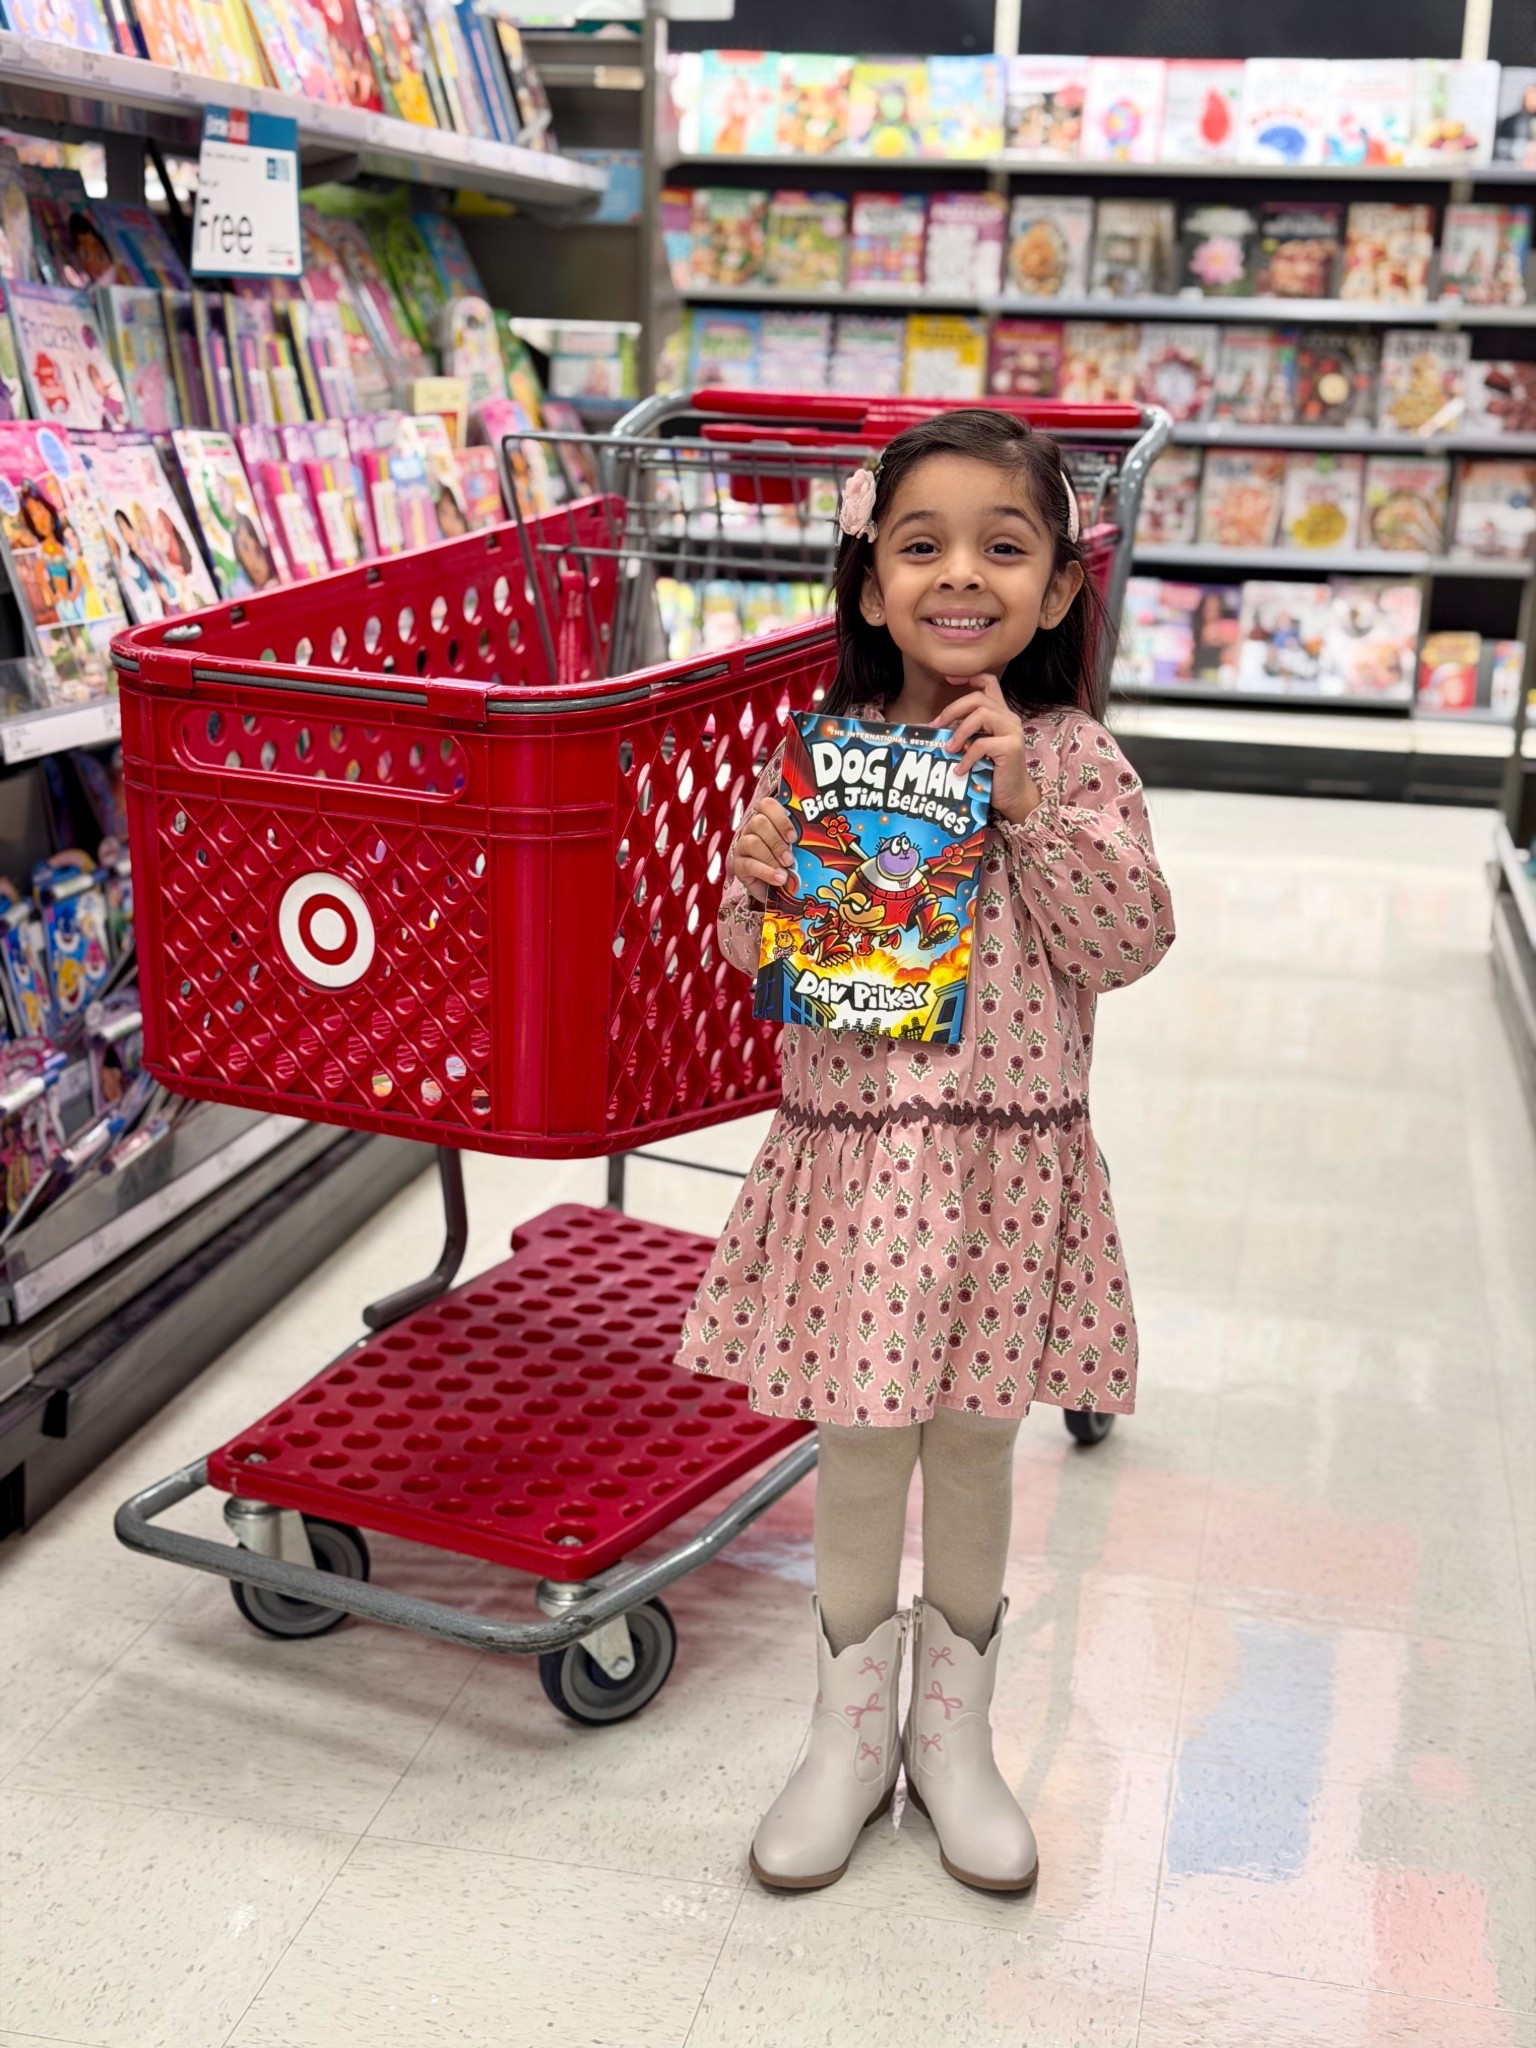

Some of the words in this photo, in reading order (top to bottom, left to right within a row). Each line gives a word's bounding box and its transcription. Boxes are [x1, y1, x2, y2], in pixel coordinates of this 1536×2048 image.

[196, 198, 253, 254] Free
[830, 729, 845, 737] THE
[847, 731, 907, 744] INTERNATIONAL
[811, 742, 888, 789] DOG
[893, 750, 969, 801] MAN
[794, 970, 847, 1004] DAV
